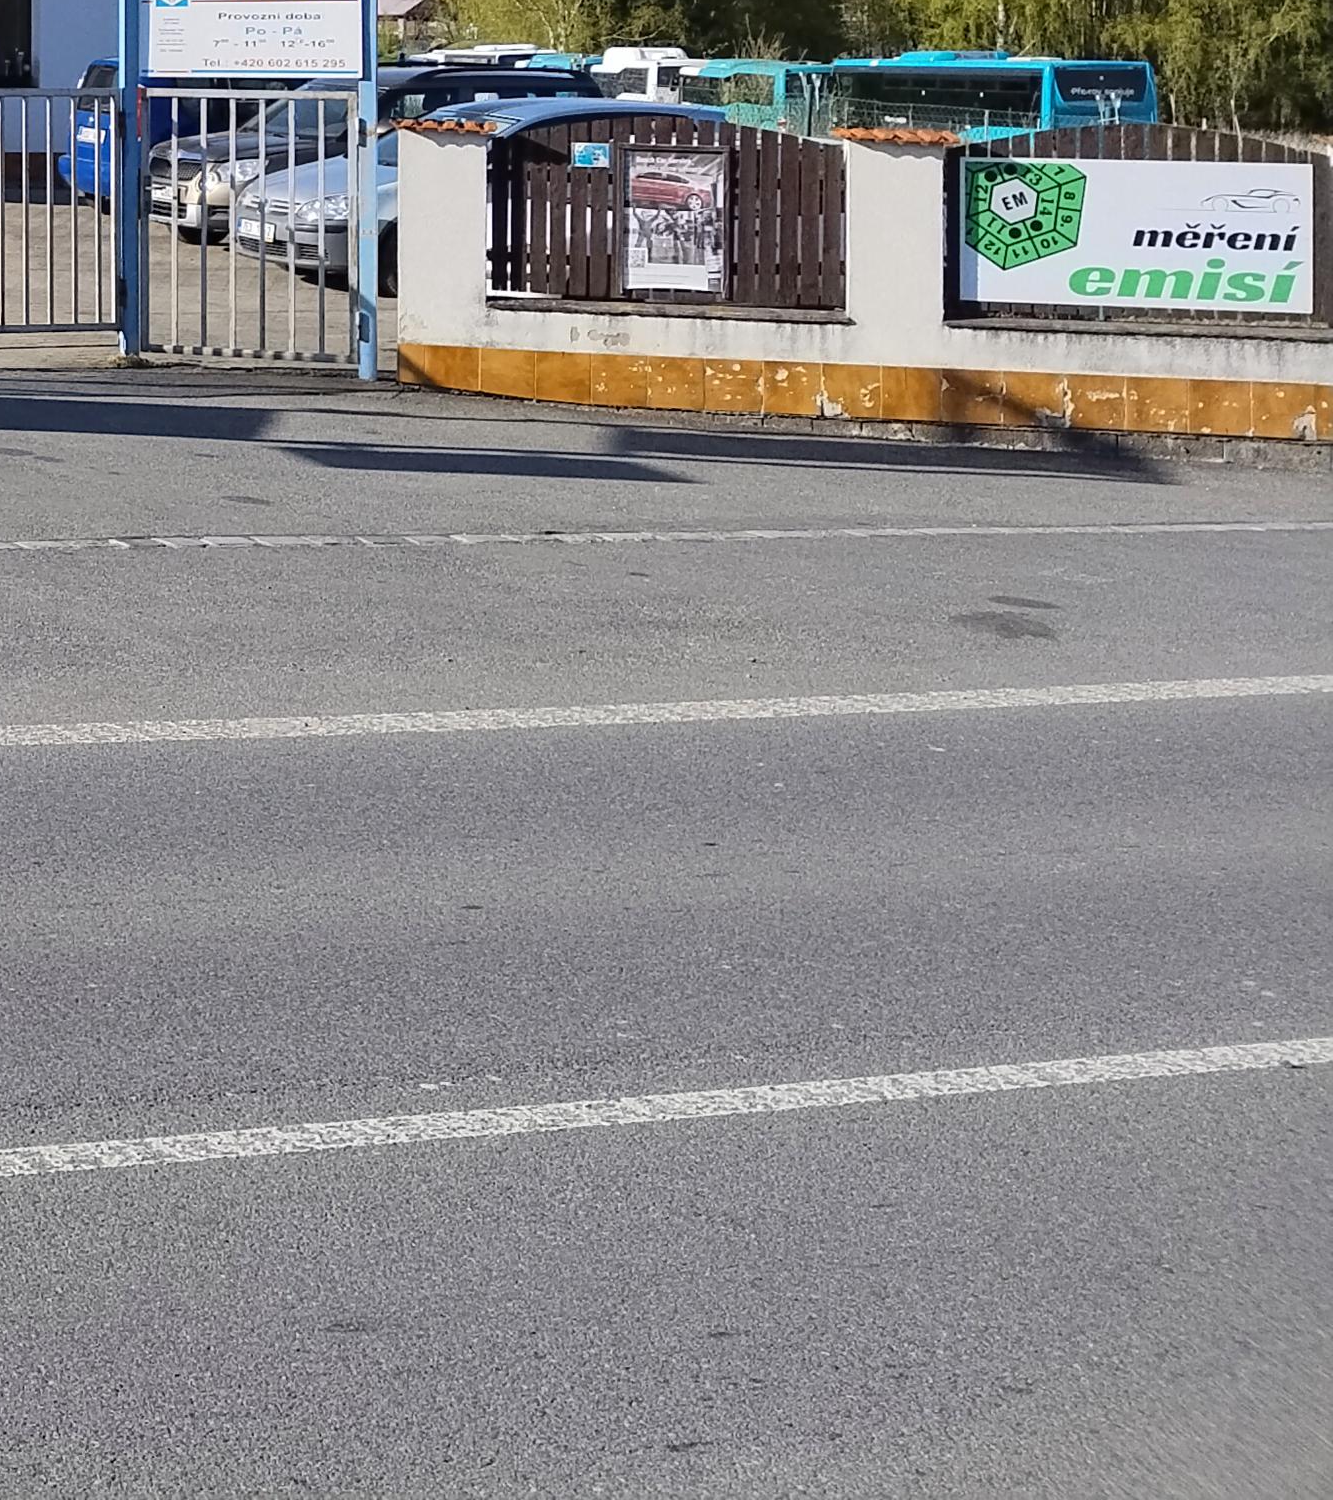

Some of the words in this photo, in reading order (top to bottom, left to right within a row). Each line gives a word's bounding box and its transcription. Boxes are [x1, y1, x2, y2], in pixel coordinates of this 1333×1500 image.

[285, 12, 322, 21] doba
[245, 26, 267, 36] Po
[282, 26, 304, 36] Pá
[268, 58, 292, 68] 602
[322, 58, 347, 68] 295
[1020, 166, 1043, 187] 13
[1052, 166, 1066, 177] 7
[974, 184, 989, 202] 12
[1063, 191, 1076, 201] 8
[1001, 191, 1029, 212] EM
[1039, 197, 1055, 217] 14
[986, 217, 1008, 235] 11
[1040, 235, 1059, 250] 10
[1132, 223, 1301, 252] měření
[983, 240, 1002, 256] 12
[1011, 245, 1030, 260] 11
[1067, 257, 1305, 304] emisí
